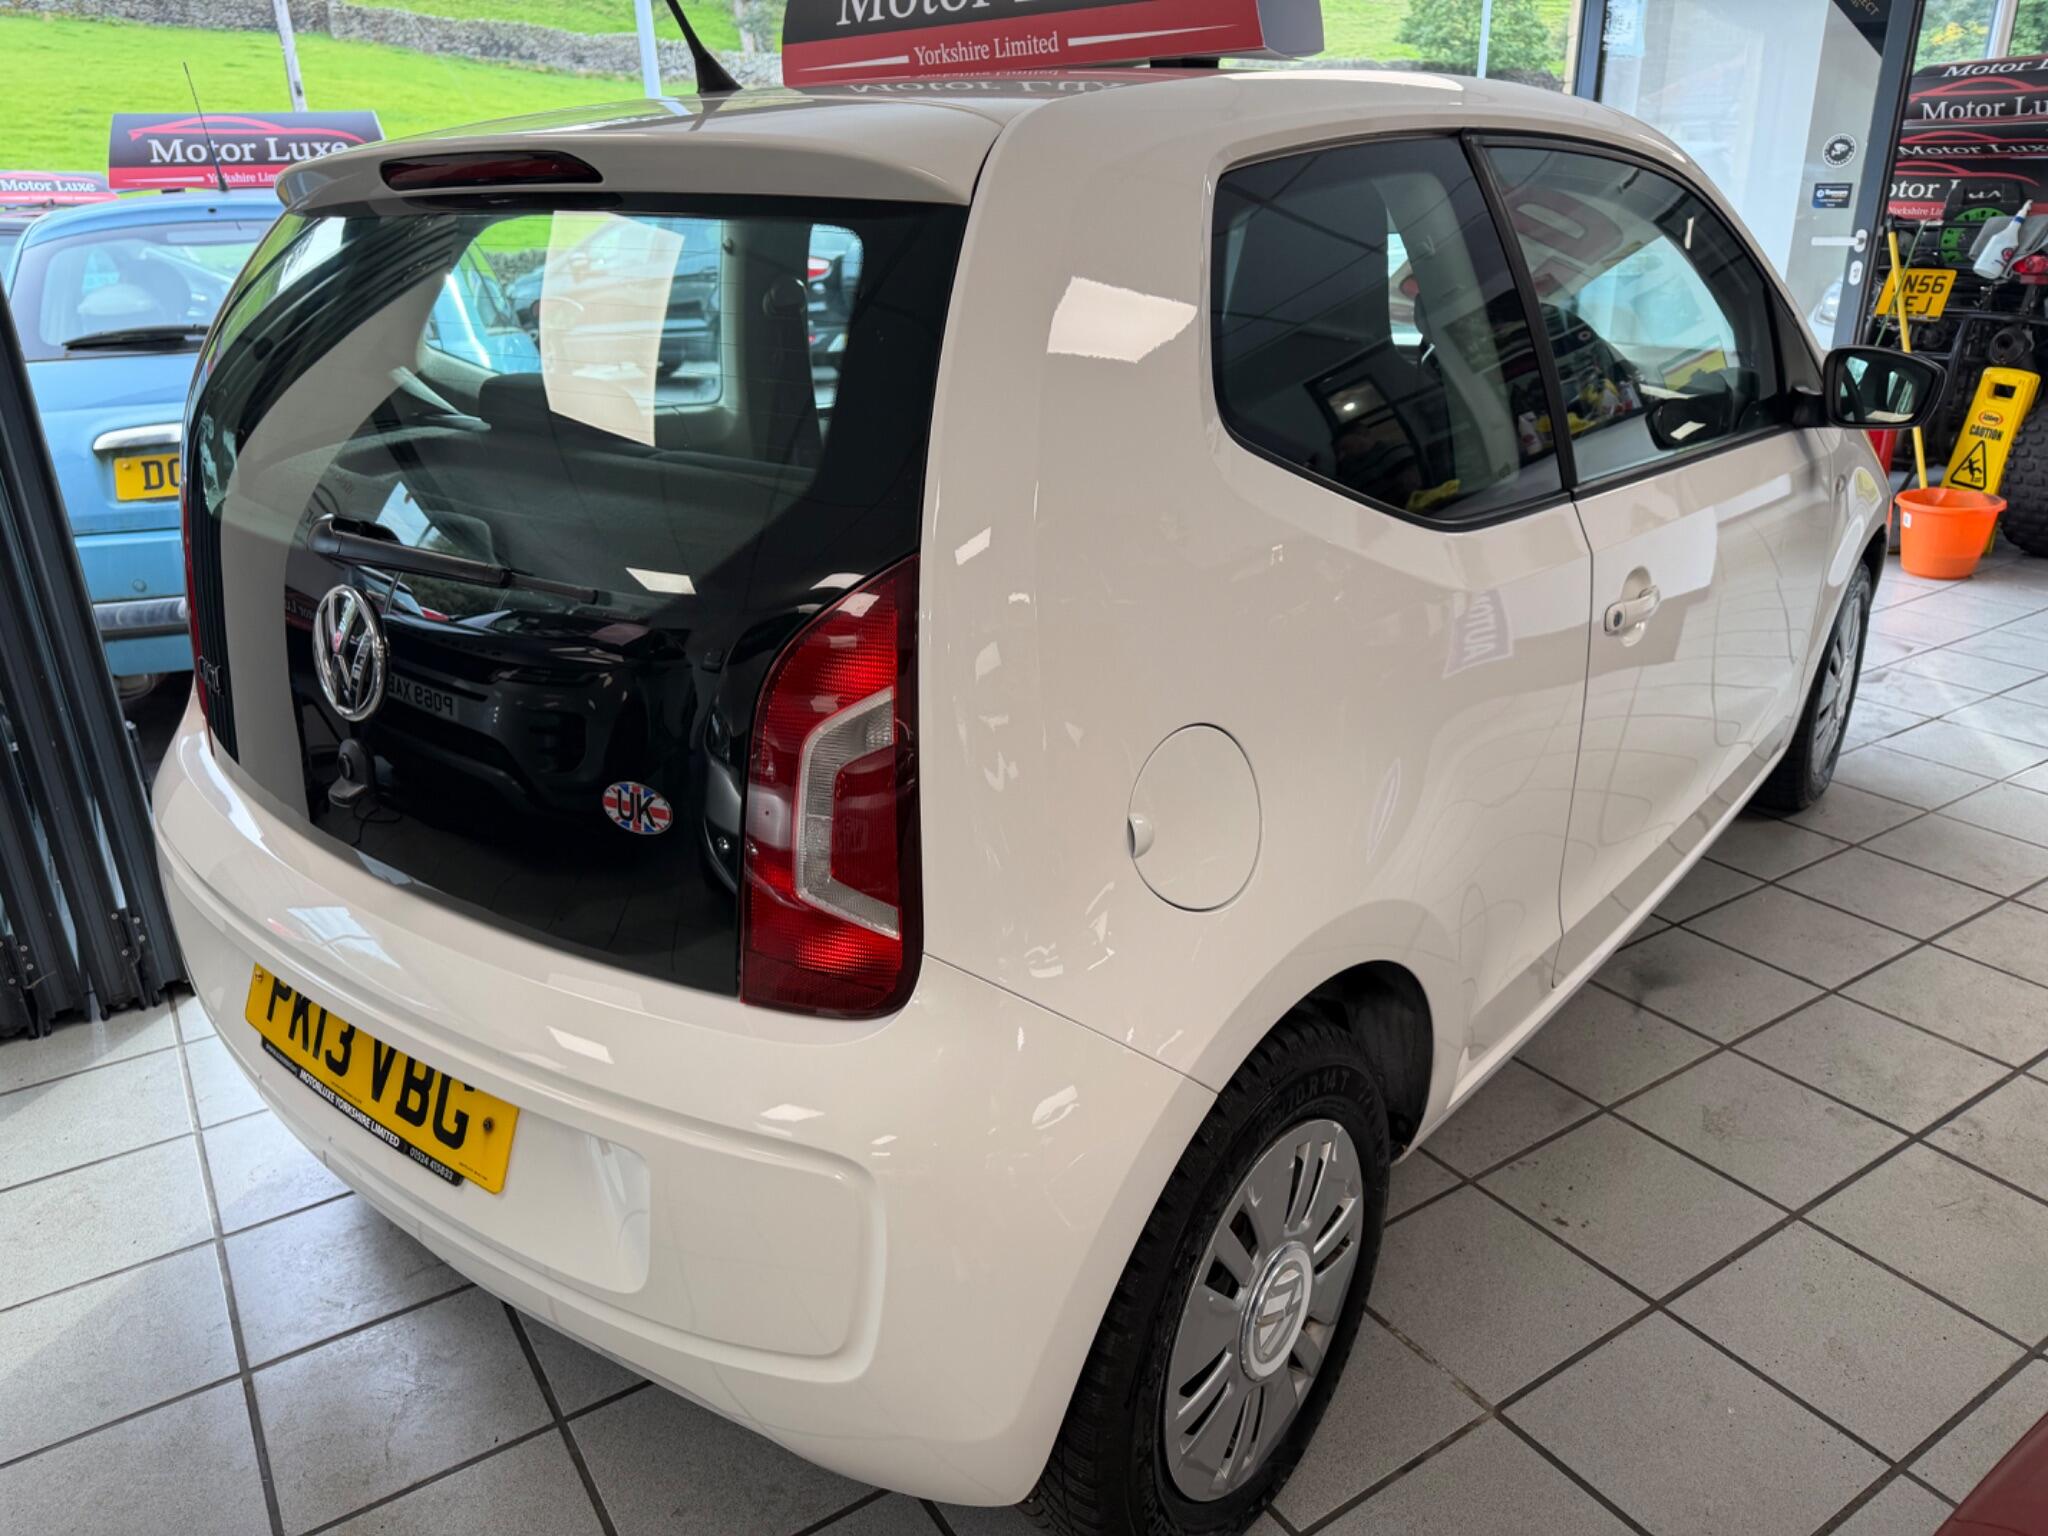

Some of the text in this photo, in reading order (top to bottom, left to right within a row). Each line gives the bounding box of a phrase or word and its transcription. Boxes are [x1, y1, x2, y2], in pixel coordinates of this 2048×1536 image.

[913, 31, 1060, 66] Yorkshire Limited
[1942, 60, 2032, 77] Motor
[1921, 100, 2006, 120] Motor
[147, 137, 348, 163] Motor Luxe
[1898, 145, 1981, 156] Motor
[0, 179, 96, 192] Motor Luxe
[1895, 274, 1947, 294] N56
[617, 788, 656, 828] UK
[265, 976, 476, 1151] PK13 VBG
[335, 1096, 371, 1129] YORKSHIRE
[370, 1120, 401, 1148] LIMITED
